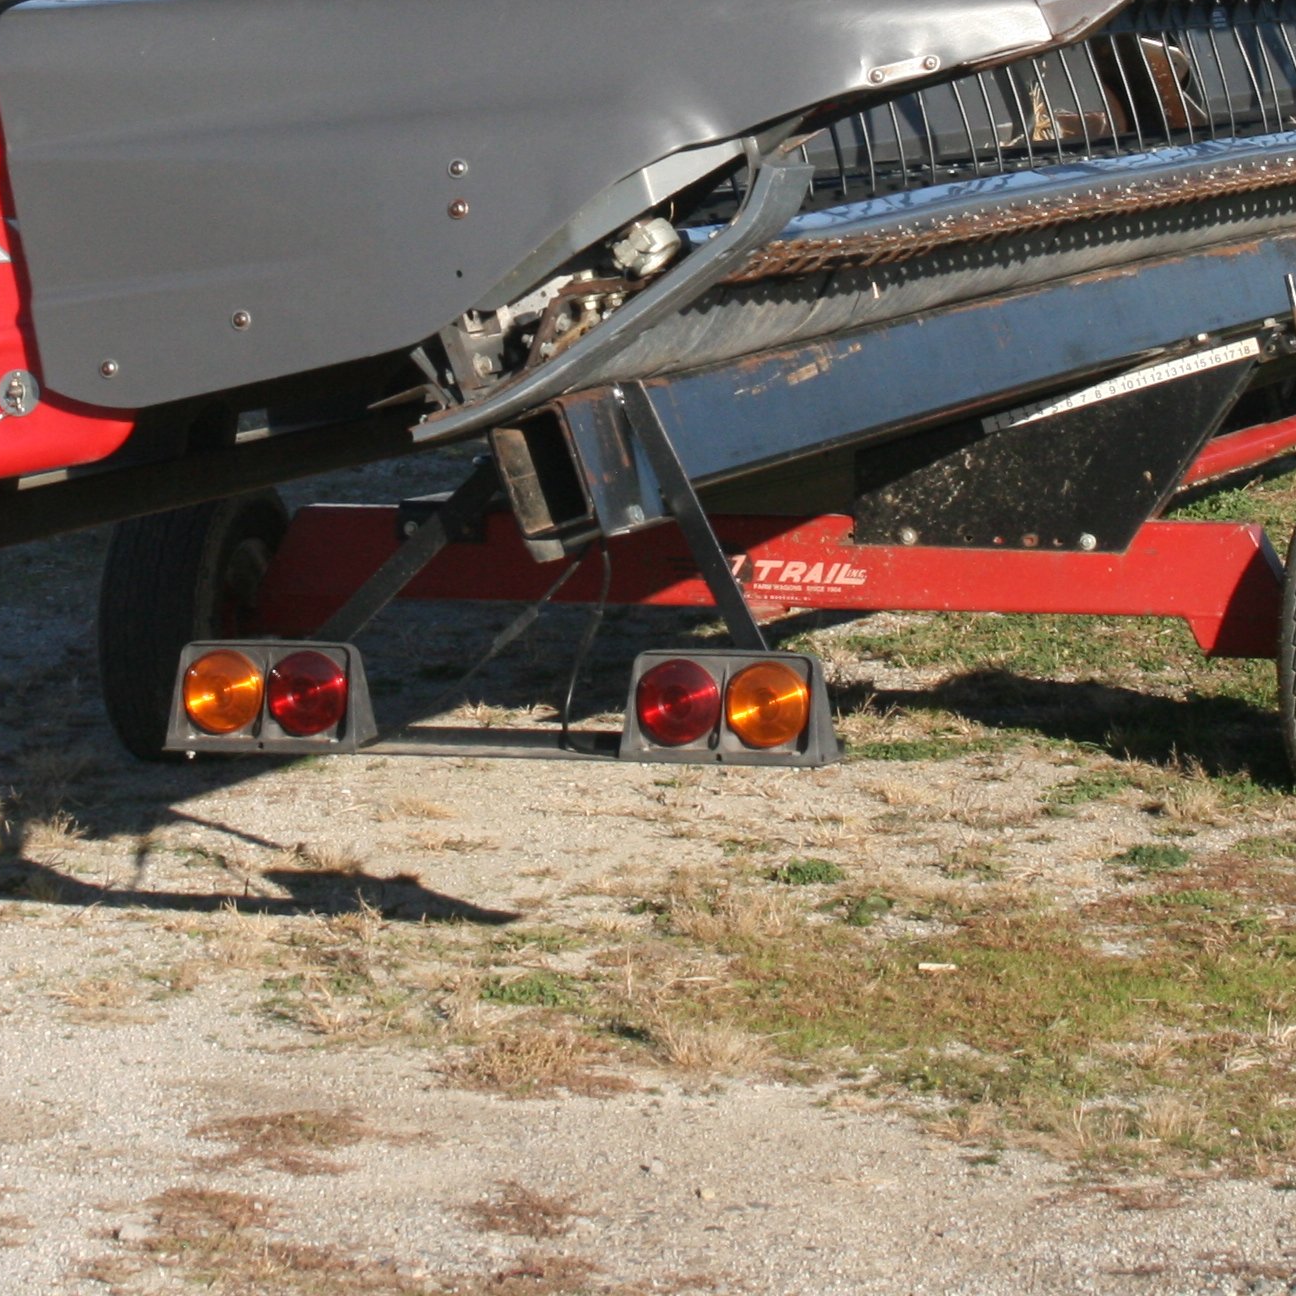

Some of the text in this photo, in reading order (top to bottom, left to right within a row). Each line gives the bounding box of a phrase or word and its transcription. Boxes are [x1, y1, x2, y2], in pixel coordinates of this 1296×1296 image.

[1079, 394, 1086, 402] 7
[1094, 390, 1102, 399] 8
[1109, 386, 1116, 394] 9
[1122, 380, 1134, 390] 10
[1136, 377, 1147, 386] 11
[1150, 372, 1162, 381] 12
[1165, 367, 1177, 377] 13
[1179, 363, 1192, 373] 14
[1194, 358, 1206, 368] 15
[1209, 354, 1221, 364] 16
[1224, 350, 1235, 360] 17
[1238, 345, 1250, 356] 18
[754, 559, 865, 585] TRAIL
